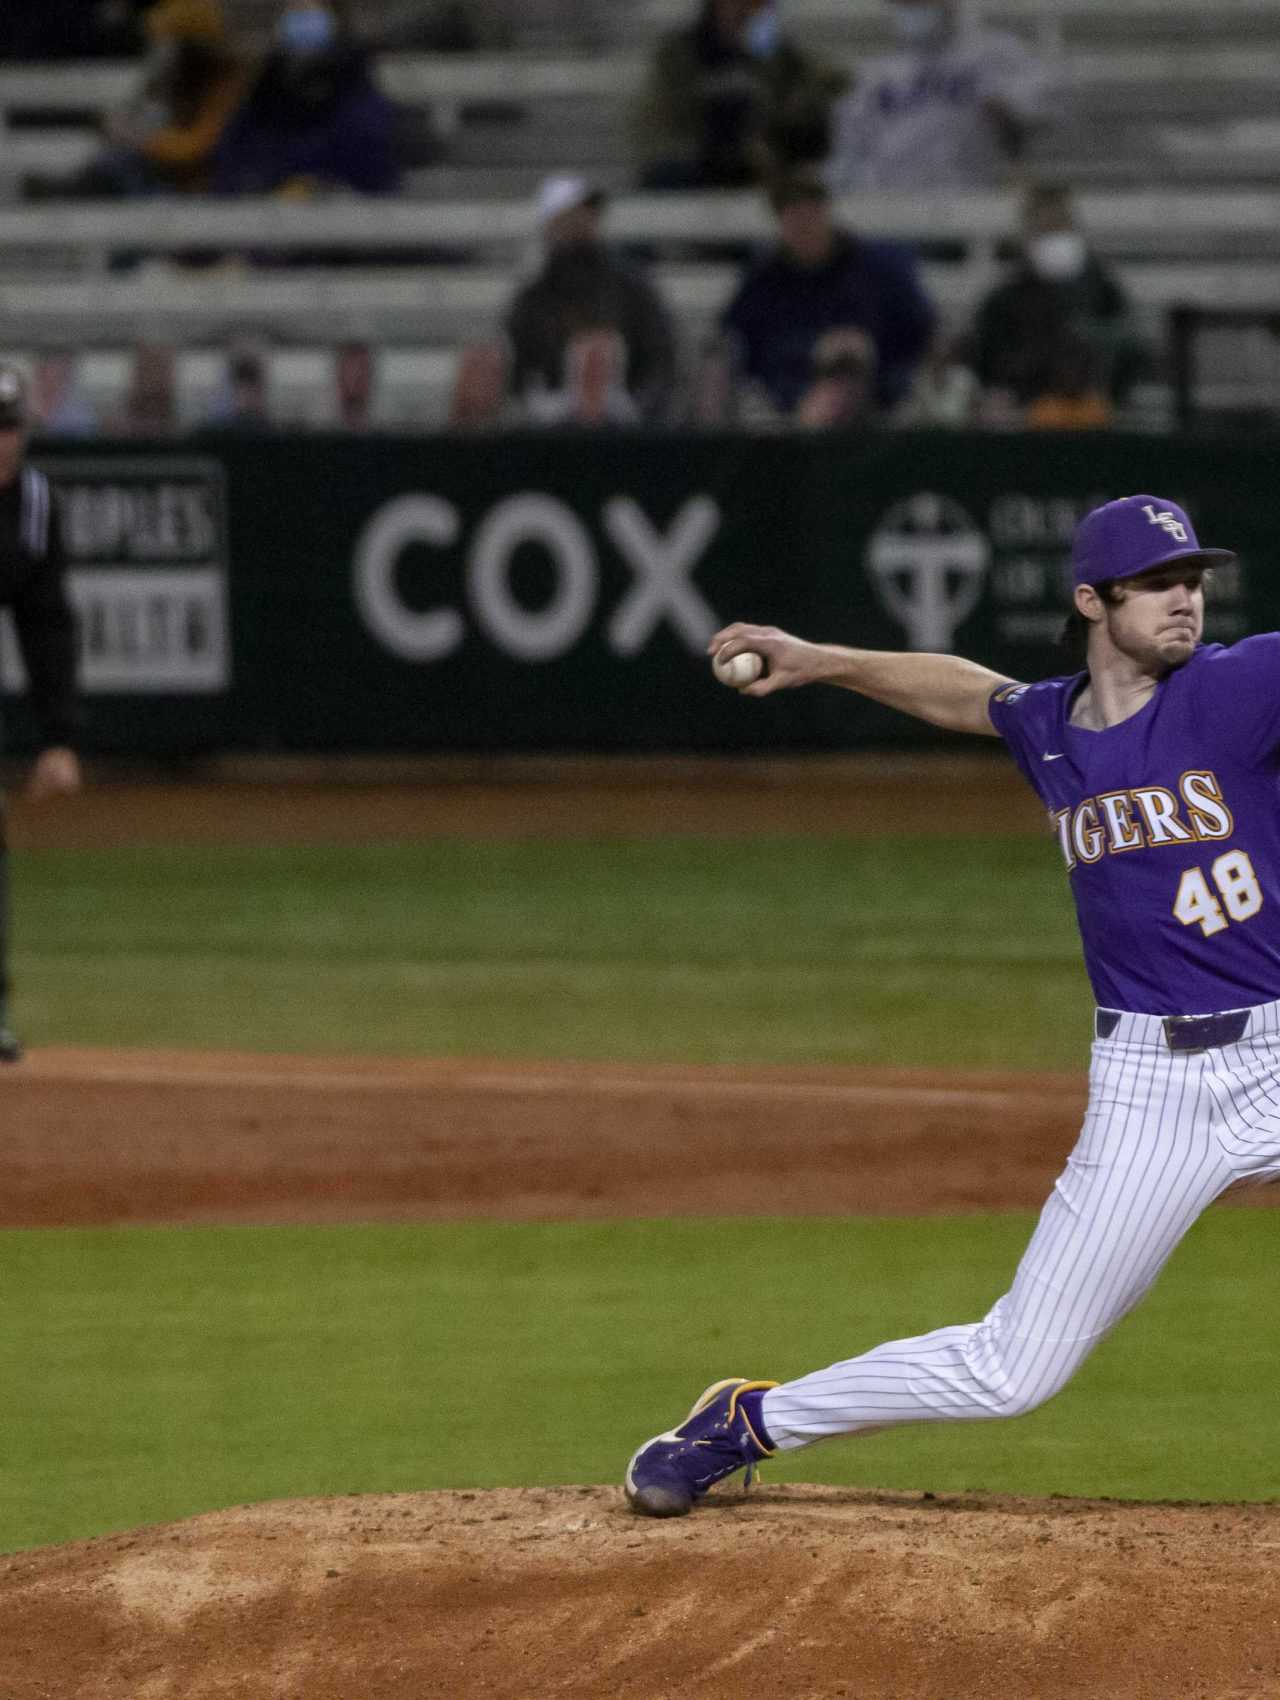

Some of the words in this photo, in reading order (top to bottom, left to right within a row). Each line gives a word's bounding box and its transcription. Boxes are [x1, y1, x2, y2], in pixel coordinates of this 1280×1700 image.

[1141, 505, 1188, 542] LSU
[353, 492, 721, 661] COX
[1054, 770, 1234, 872] IGERS
[1173, 848, 1264, 937] 48
